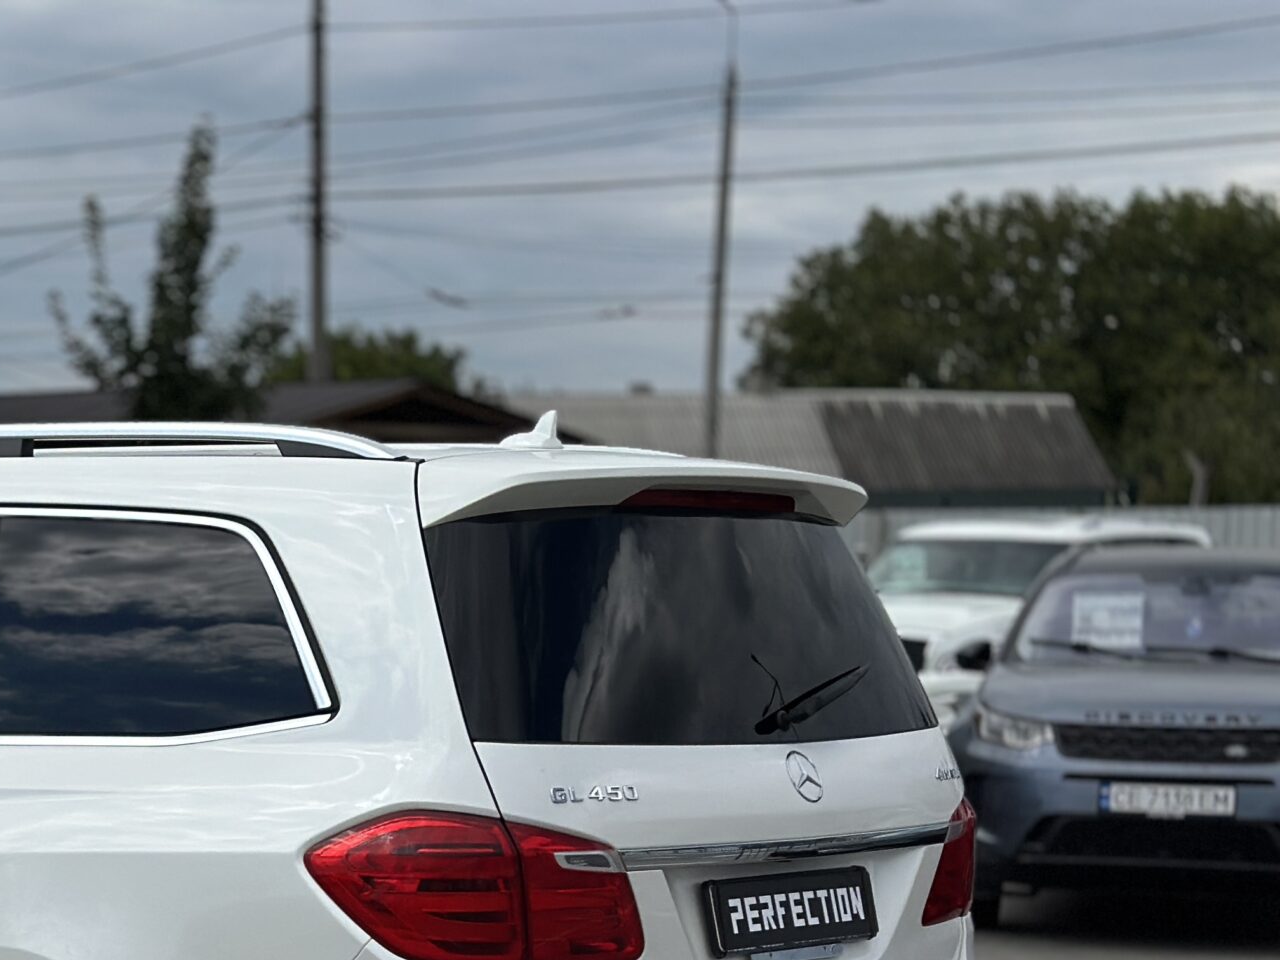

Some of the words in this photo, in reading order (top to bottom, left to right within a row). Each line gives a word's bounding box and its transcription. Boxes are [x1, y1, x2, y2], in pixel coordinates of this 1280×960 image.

[550, 786, 585, 804] GL
[588, 784, 639, 802] 450
[728, 886, 865, 934] PERFECTION
